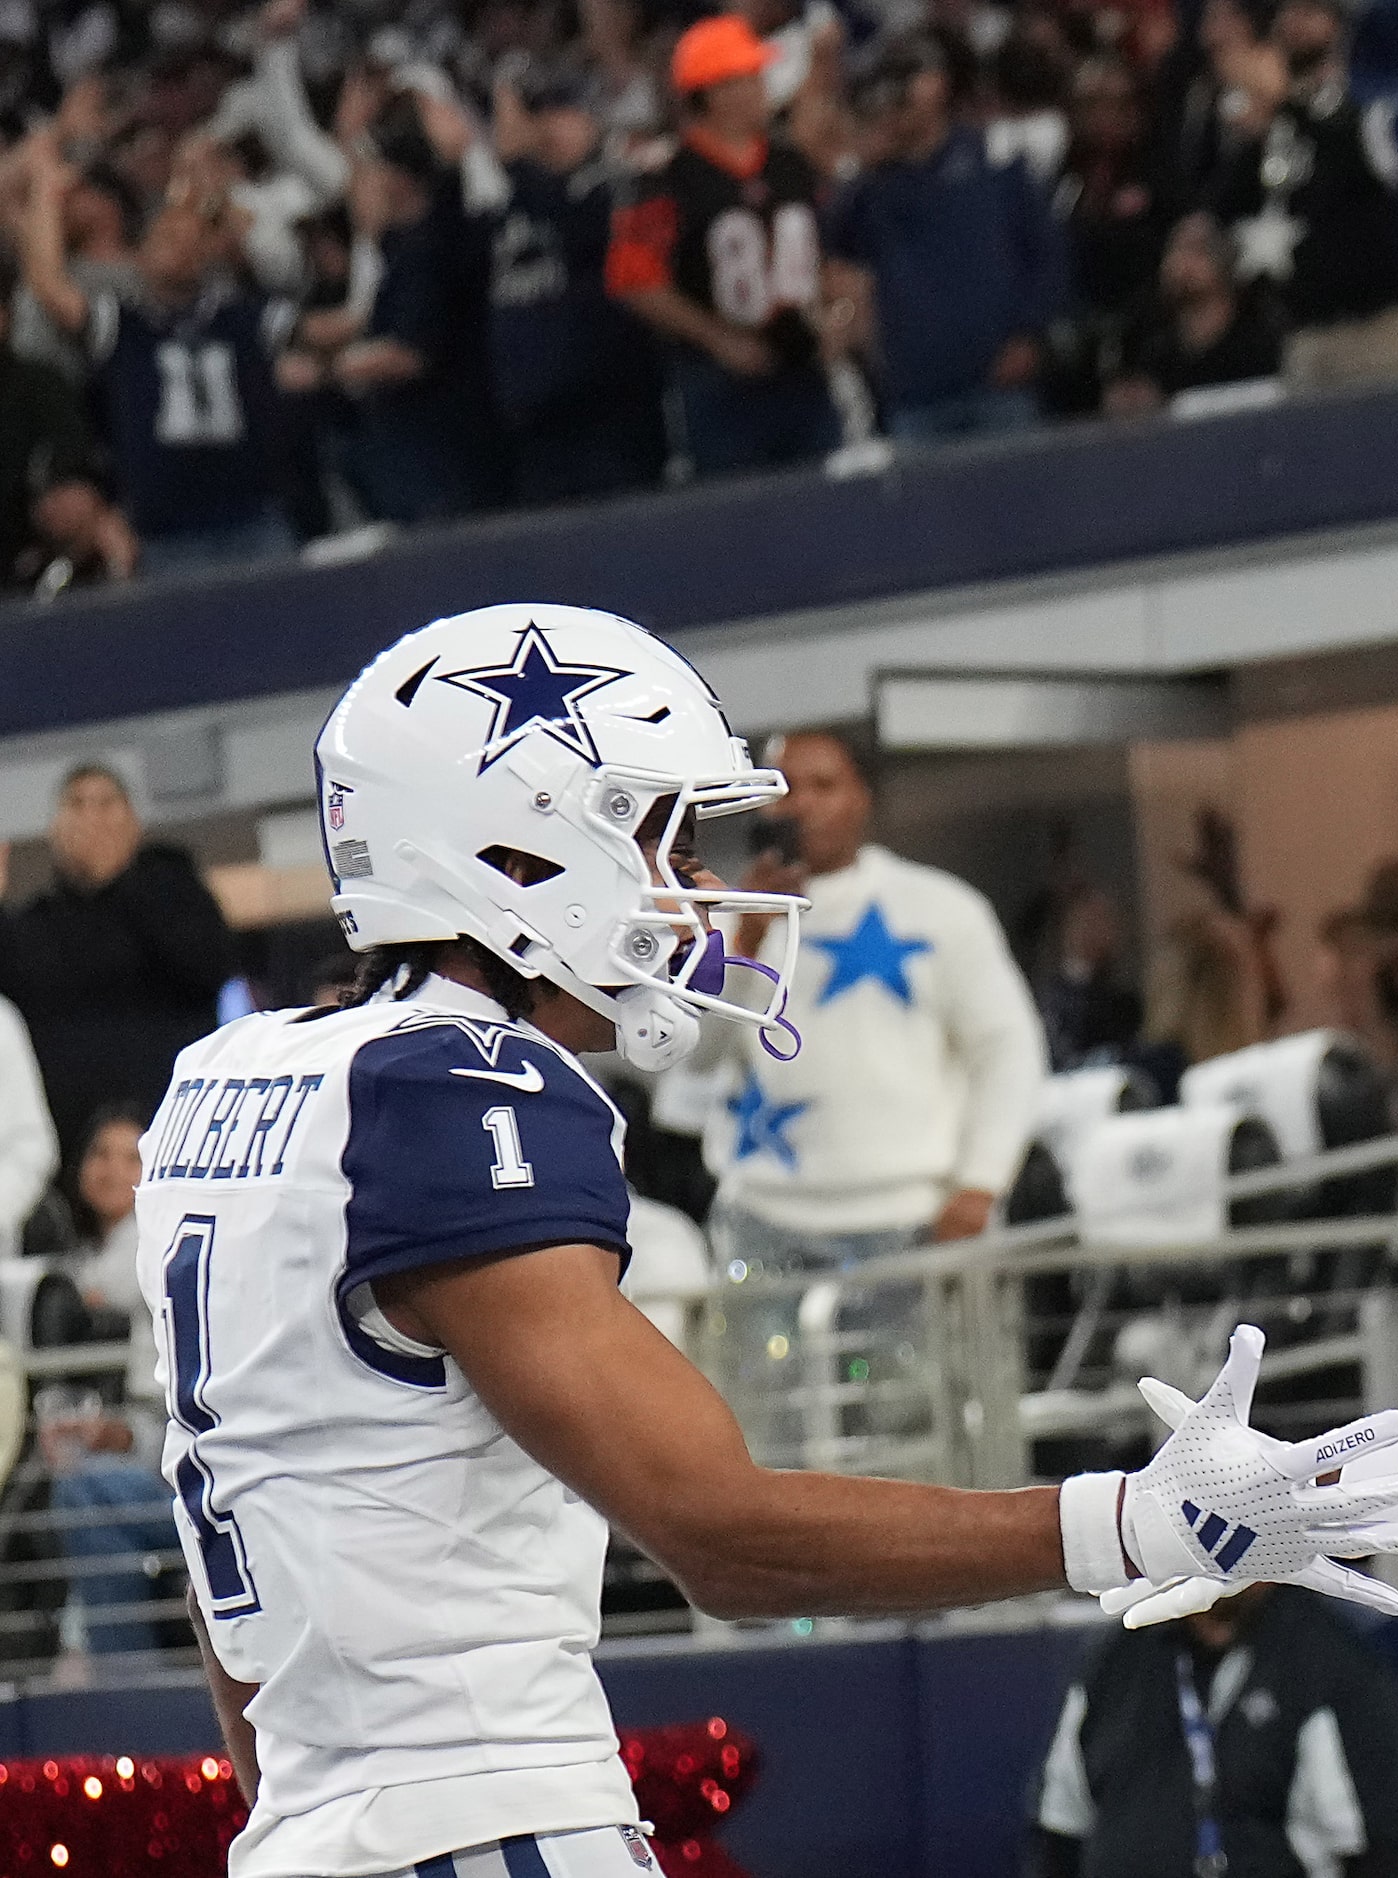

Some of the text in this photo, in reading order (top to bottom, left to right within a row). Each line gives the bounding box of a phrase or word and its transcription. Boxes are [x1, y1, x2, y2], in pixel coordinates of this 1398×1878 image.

[148, 1073, 325, 1181] TOLBERT
[482, 1106, 535, 1190] 1
[161, 1213, 263, 1621] 1
[1316, 1428, 1375, 1463] ADIZERO
